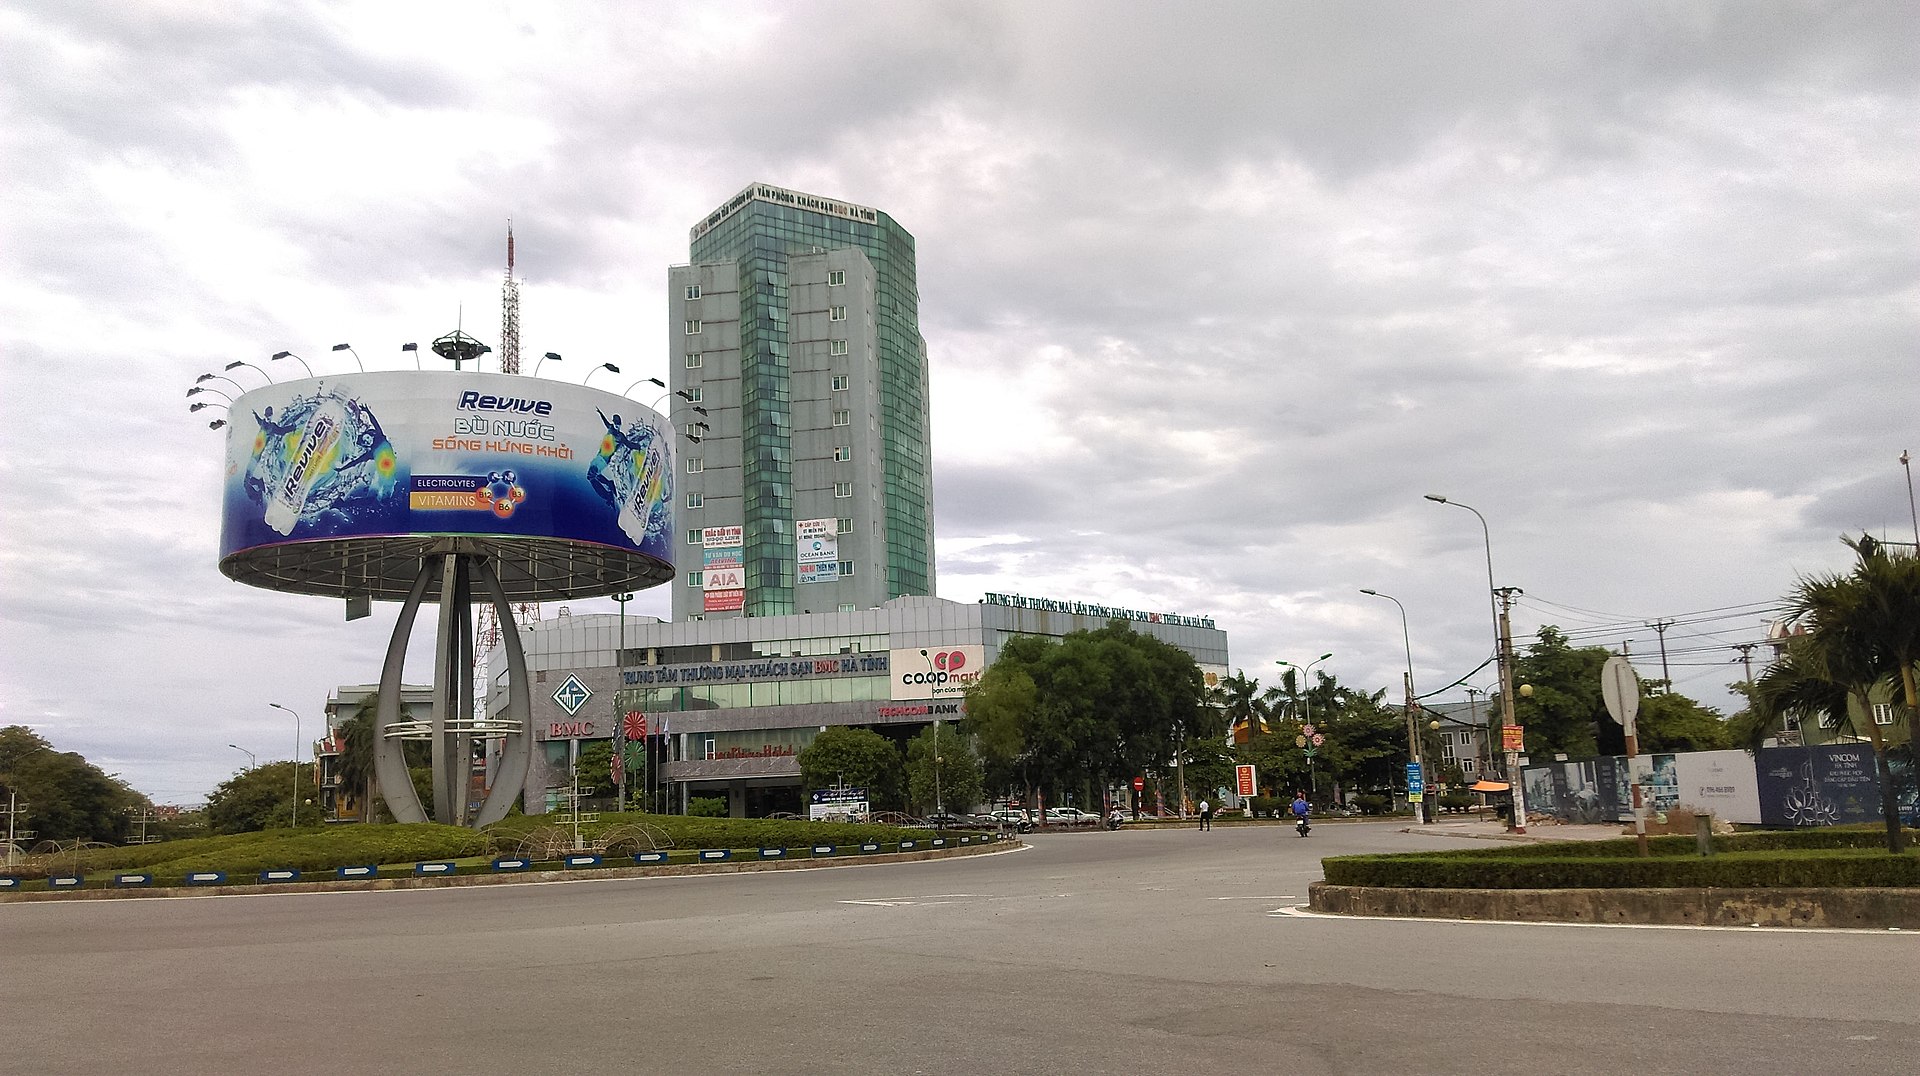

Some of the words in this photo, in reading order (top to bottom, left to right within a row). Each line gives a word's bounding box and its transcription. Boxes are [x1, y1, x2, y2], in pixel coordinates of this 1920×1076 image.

[457, 390, 553, 417] Revive
[455, 415, 488, 435] BÙ
[493, 419, 555, 441] NƯỚC
[285, 420, 327, 497] Revive
[432, 435, 481, 451] SỐNG
[486, 438, 533, 454] HỨNG
[537, 443, 575, 460] KHỞI
[417, 479, 476, 488] ELECTROLYTES
[636, 451, 659, 512] Revive
[418, 496, 476, 507] VITAMINS
[479, 491, 492, 499] B12
[709, 572, 739, 587] AIA
[985, 592, 1011, 607] TRUNG
[1011, 593, 1026, 609] TÂM
[1111, 606, 1134, 621] KHÁCH
[655, 667, 678, 683] TÂM
[790, 660, 813, 678] SẠN
[814, 660, 840, 675] BMC
[841, 656, 859, 673] HÀ
[860, 654, 887, 671] TĨNH
[878, 704, 958, 717] TECHCOMBANK
[550, 720, 595, 738] BMC
